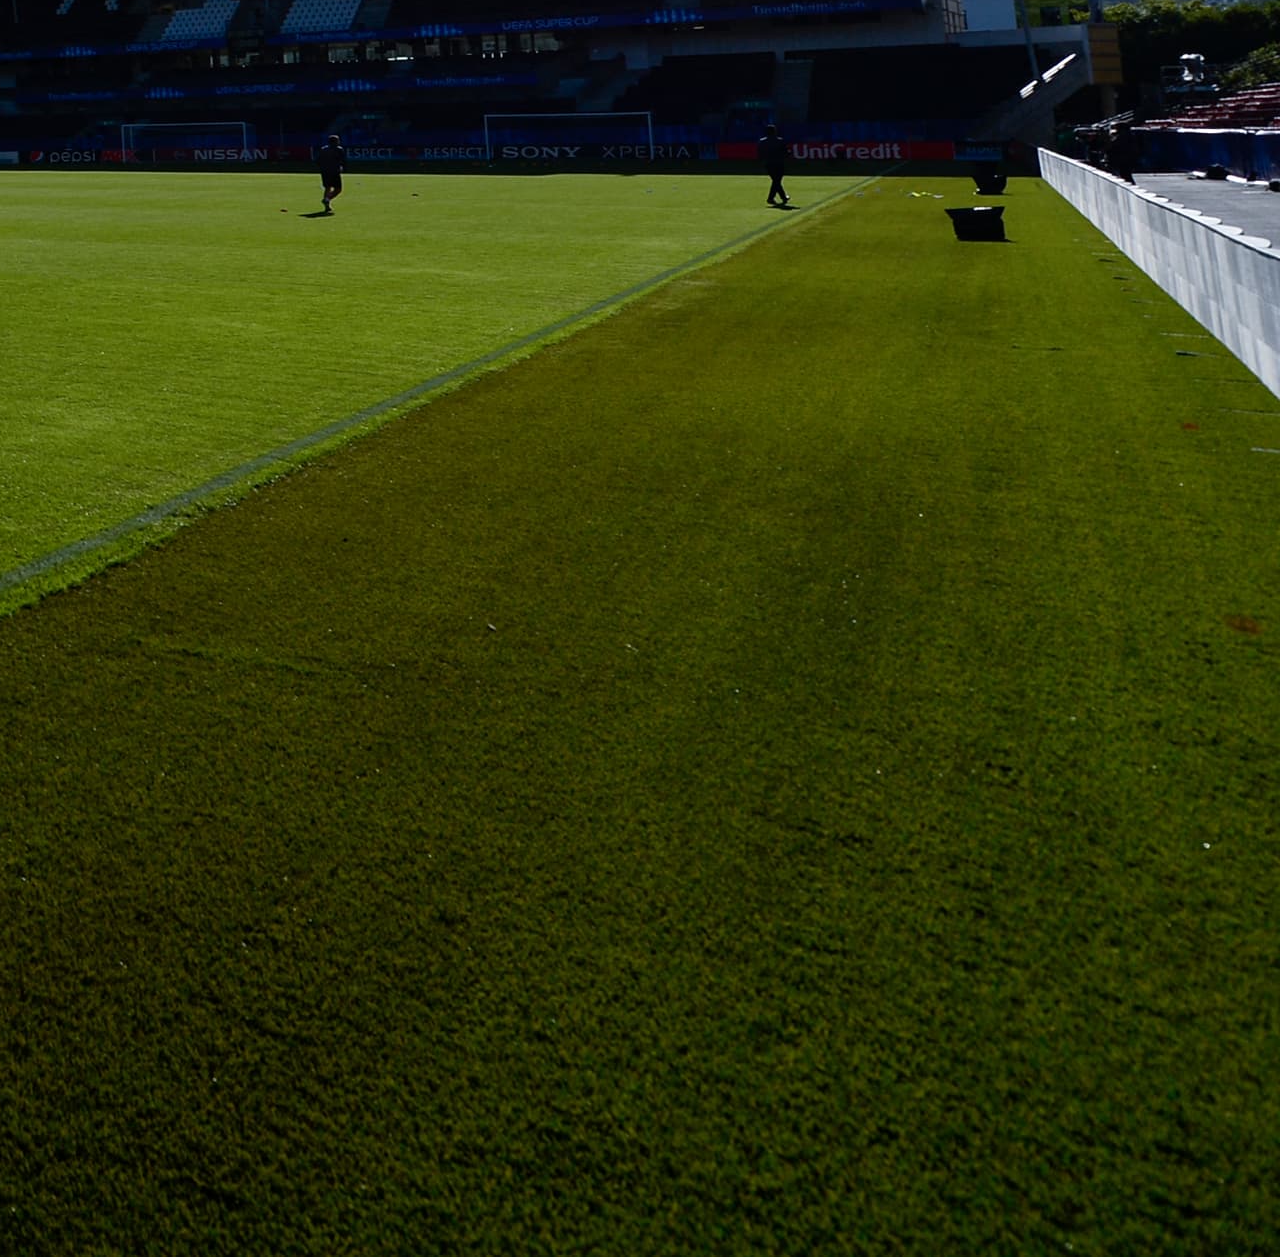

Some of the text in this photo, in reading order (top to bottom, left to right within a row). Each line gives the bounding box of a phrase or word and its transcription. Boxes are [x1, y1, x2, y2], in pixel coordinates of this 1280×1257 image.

[501, 20, 534, 31] UEFA
[194, 149, 268, 160] NISSAN
[346, 147, 392, 159] ESPECT
[424, 147, 485, 160] RESPECT
[502, 145, 690, 158] SONY XPERIA
[792, 143, 902, 160] UniCredit
